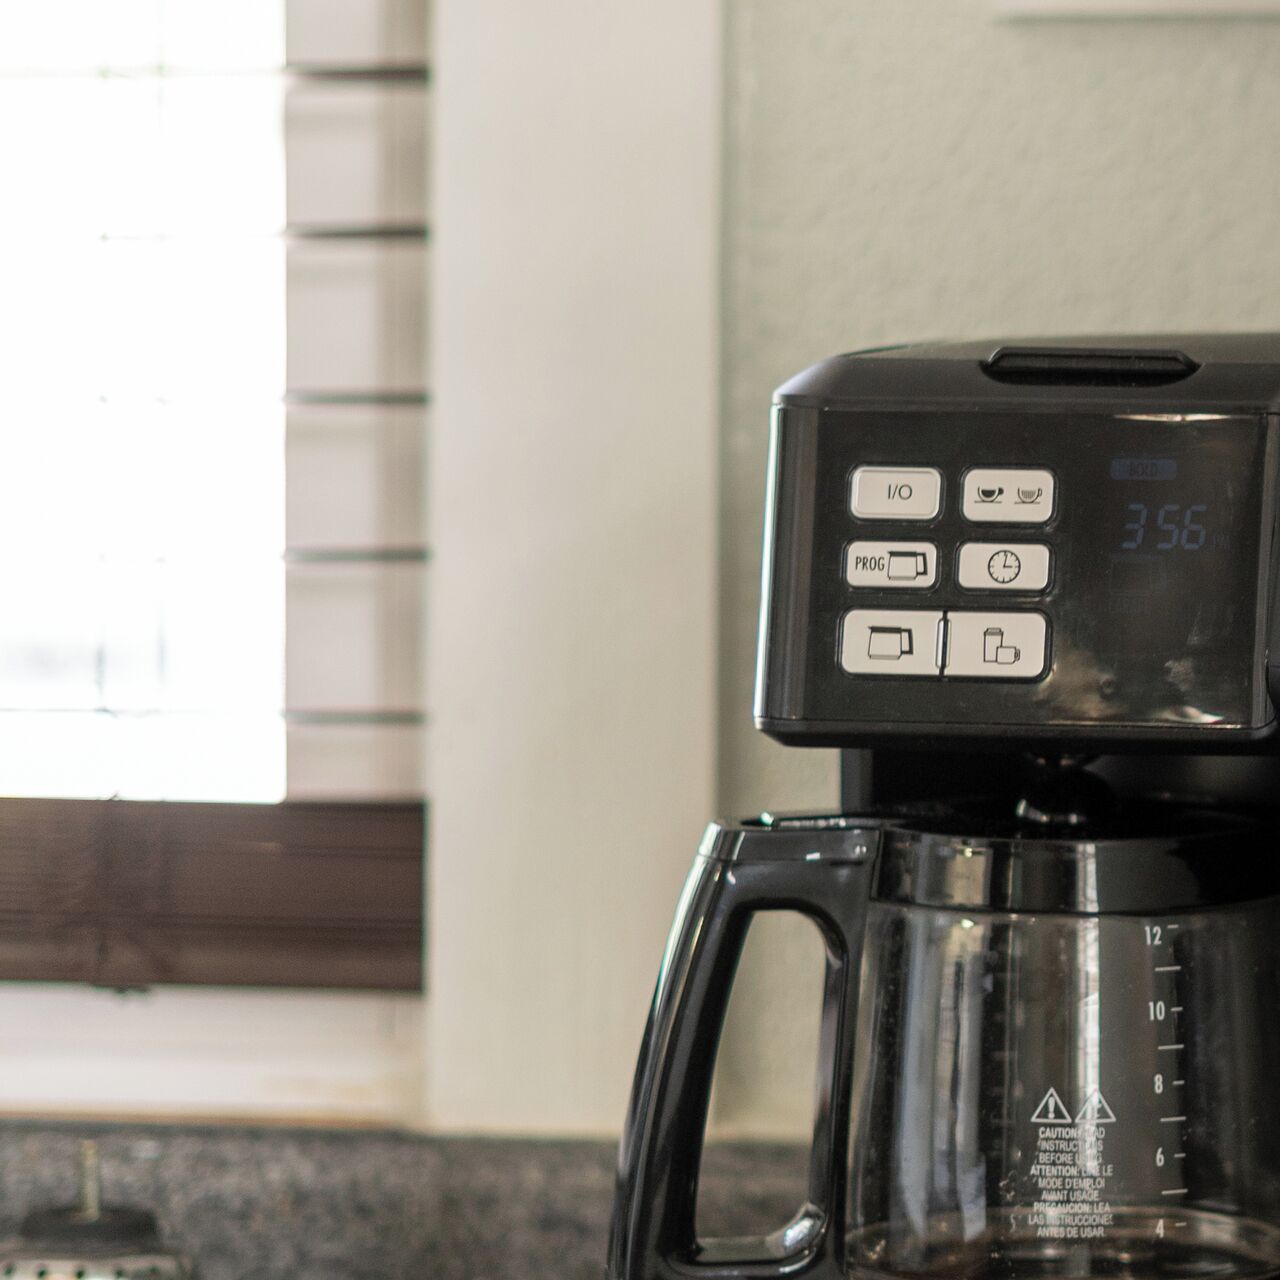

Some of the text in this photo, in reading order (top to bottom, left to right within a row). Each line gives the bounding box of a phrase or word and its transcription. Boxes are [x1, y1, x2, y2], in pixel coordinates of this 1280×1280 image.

[855, 556, 885, 572] PROG
[1145, 926, 1162, 945] 12
[1148, 1001, 1165, 1021] 10
[1154, 1074, 1163, 1094] 8
[1040, 1139, 1103, 1152] INSTRUCTONS
[1039, 1152, 1072, 1165] BEFORE
[1155, 1147, 1164, 1167] 6
[1103, 1165, 1113, 1176] LE
[1038, 1177, 1105, 1189] MODE D'EMPLOI
[1041, 1190, 1067, 1201] AVANT
[1094, 1202, 1110, 1213] LEA
[1028, 1214, 1044, 1225] LAS
[1037, 1226, 1065, 1238] ANTES
[1067, 1226, 1079, 1238] DE
[1155, 1219, 1164, 1238] 4
